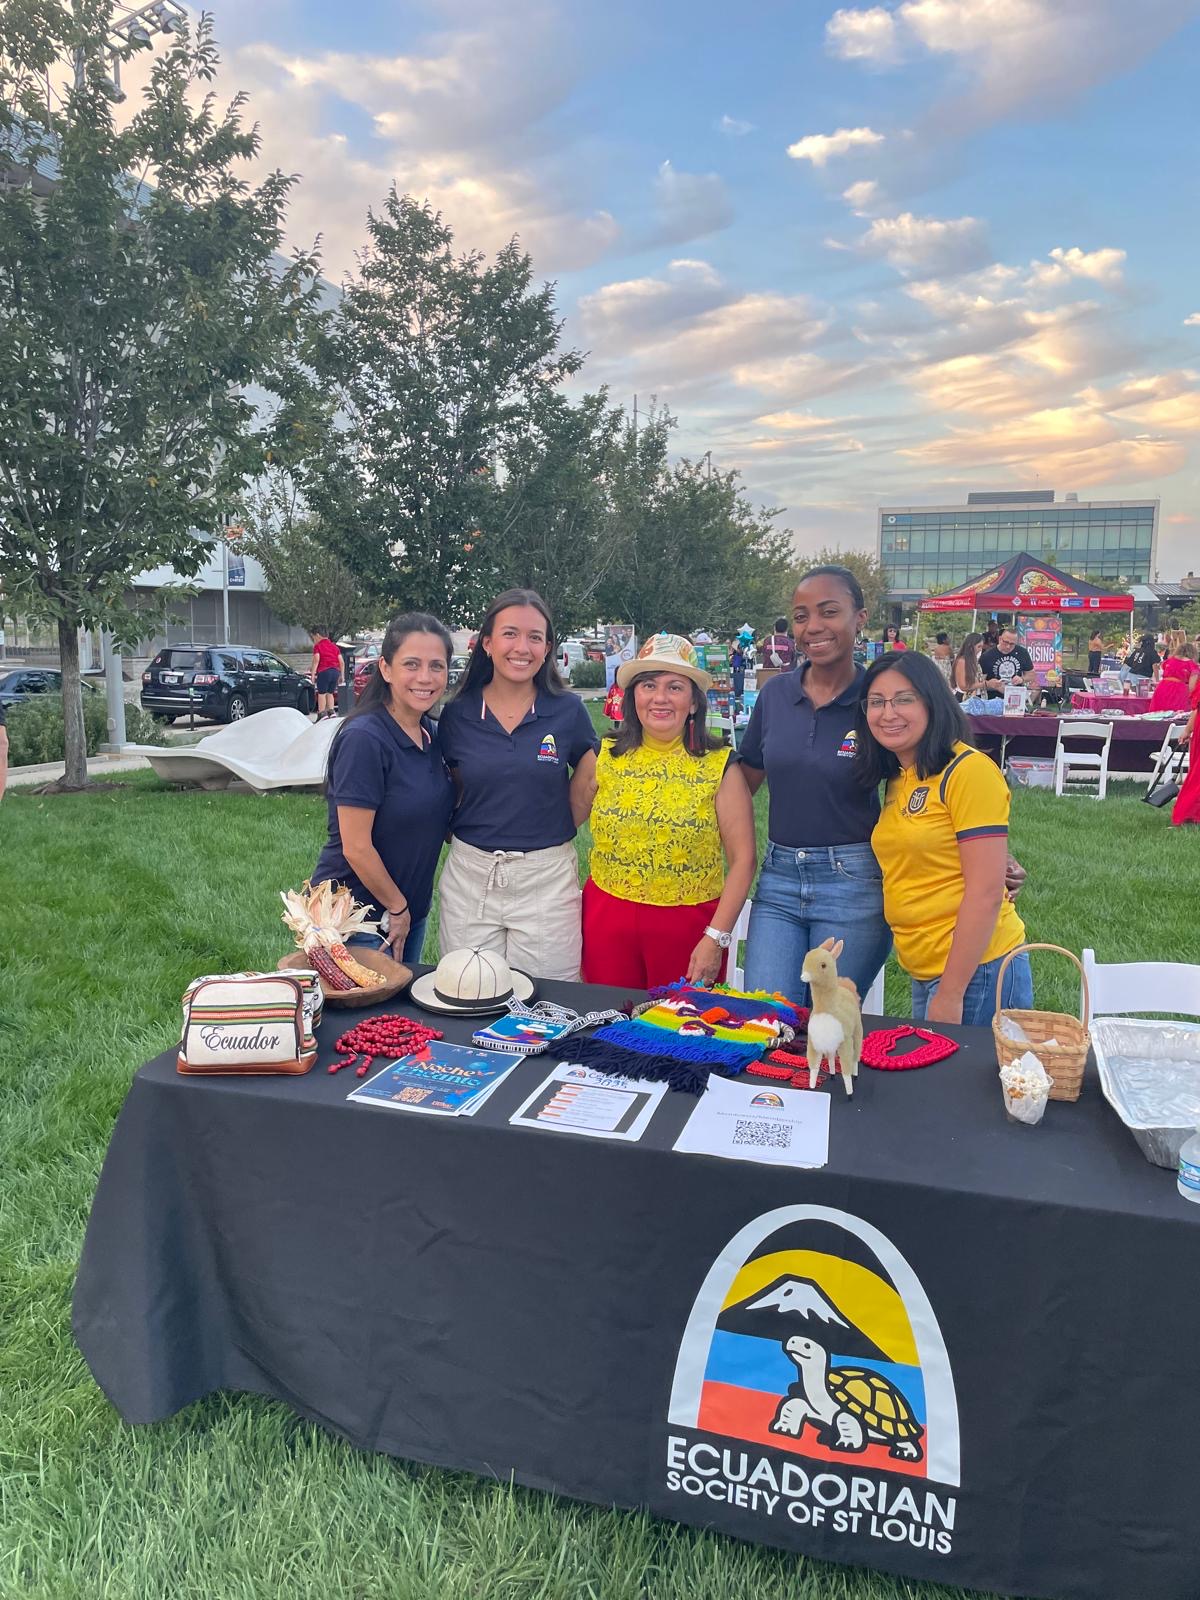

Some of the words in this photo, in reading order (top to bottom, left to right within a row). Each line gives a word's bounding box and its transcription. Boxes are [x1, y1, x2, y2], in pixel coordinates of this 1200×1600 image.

[1027, 646, 1055, 662] RISING
[200, 1026, 280, 1051] Ecuador
[413, 1061, 476, 1077] Noche
[666, 1435, 957, 1531] ECUADORIAN
[666, 1470, 781, 1516] SOCIETY
[787, 1501, 826, 1527] OF
[832, 1510, 863, 1534] ST
[870, 1515, 952, 1555] LOUIS
